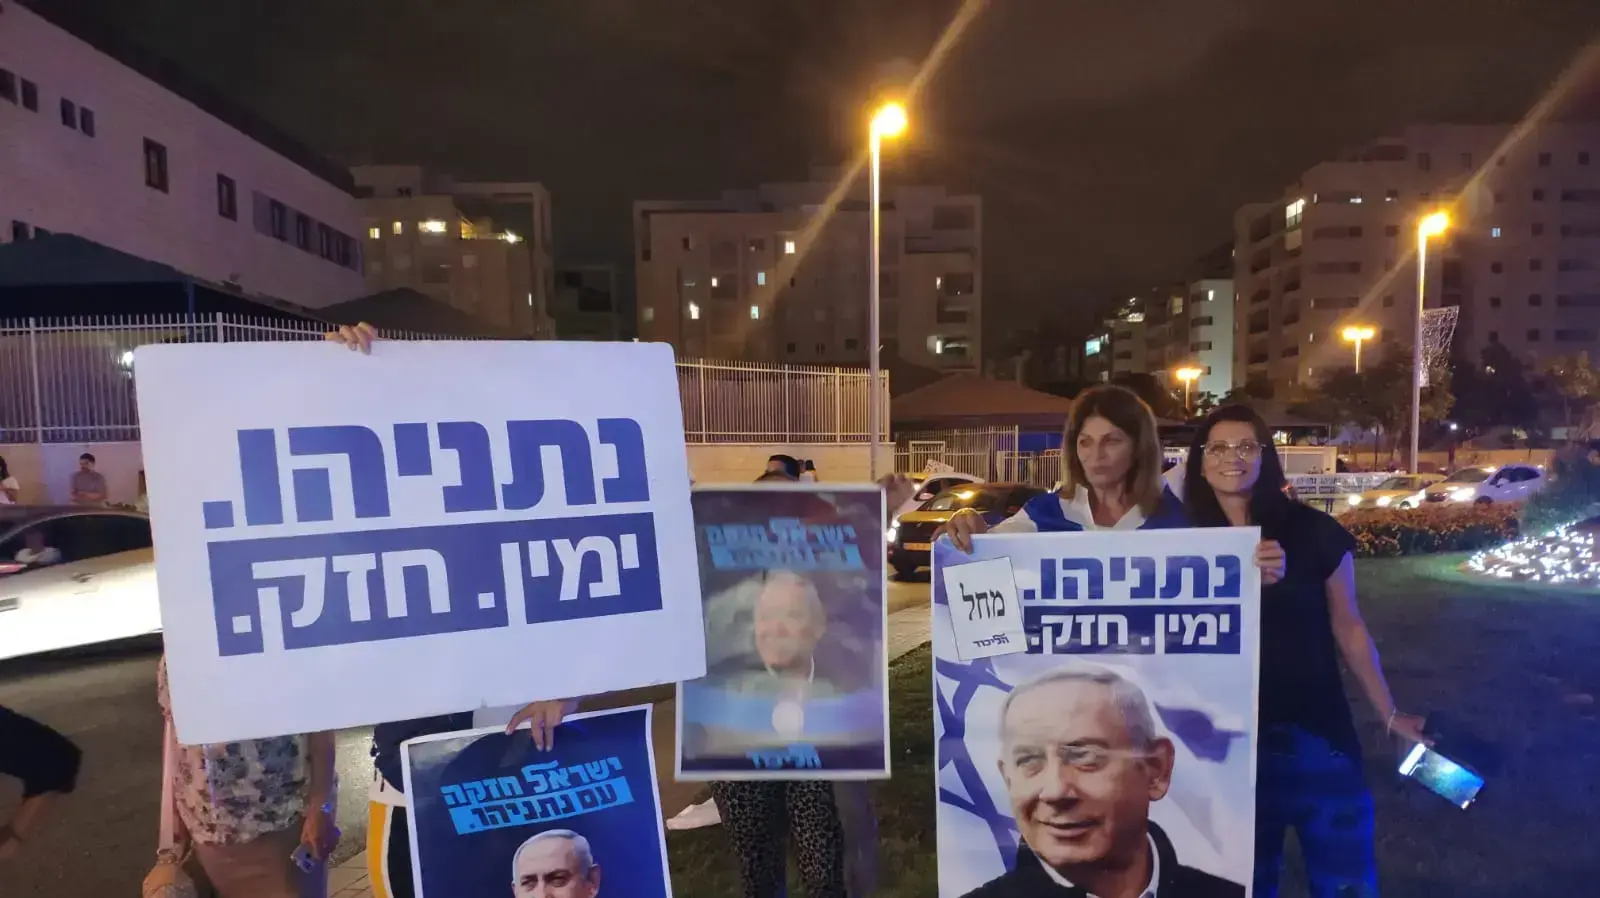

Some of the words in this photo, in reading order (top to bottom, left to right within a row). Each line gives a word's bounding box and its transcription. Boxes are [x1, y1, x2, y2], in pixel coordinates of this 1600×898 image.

[202, 417, 651, 530] נתניהו.
[477, 533, 641, 627] ימין.
[1023, 554, 1241, 600] נתניהו.
[232, 547, 452, 653] חזק.
[959, 582, 1006, 621] מחל
[972, 632, 1010, 648] הליכוד
[1030, 613, 1129, 655] חזק.
[1141, 612, 1230, 654] ימין.
[439, 775, 524, 807] חזקה
[520, 756, 623, 793] ישראל
[468, 791, 577, 829] נתניהו.
[574, 783, 619, 810] עם
